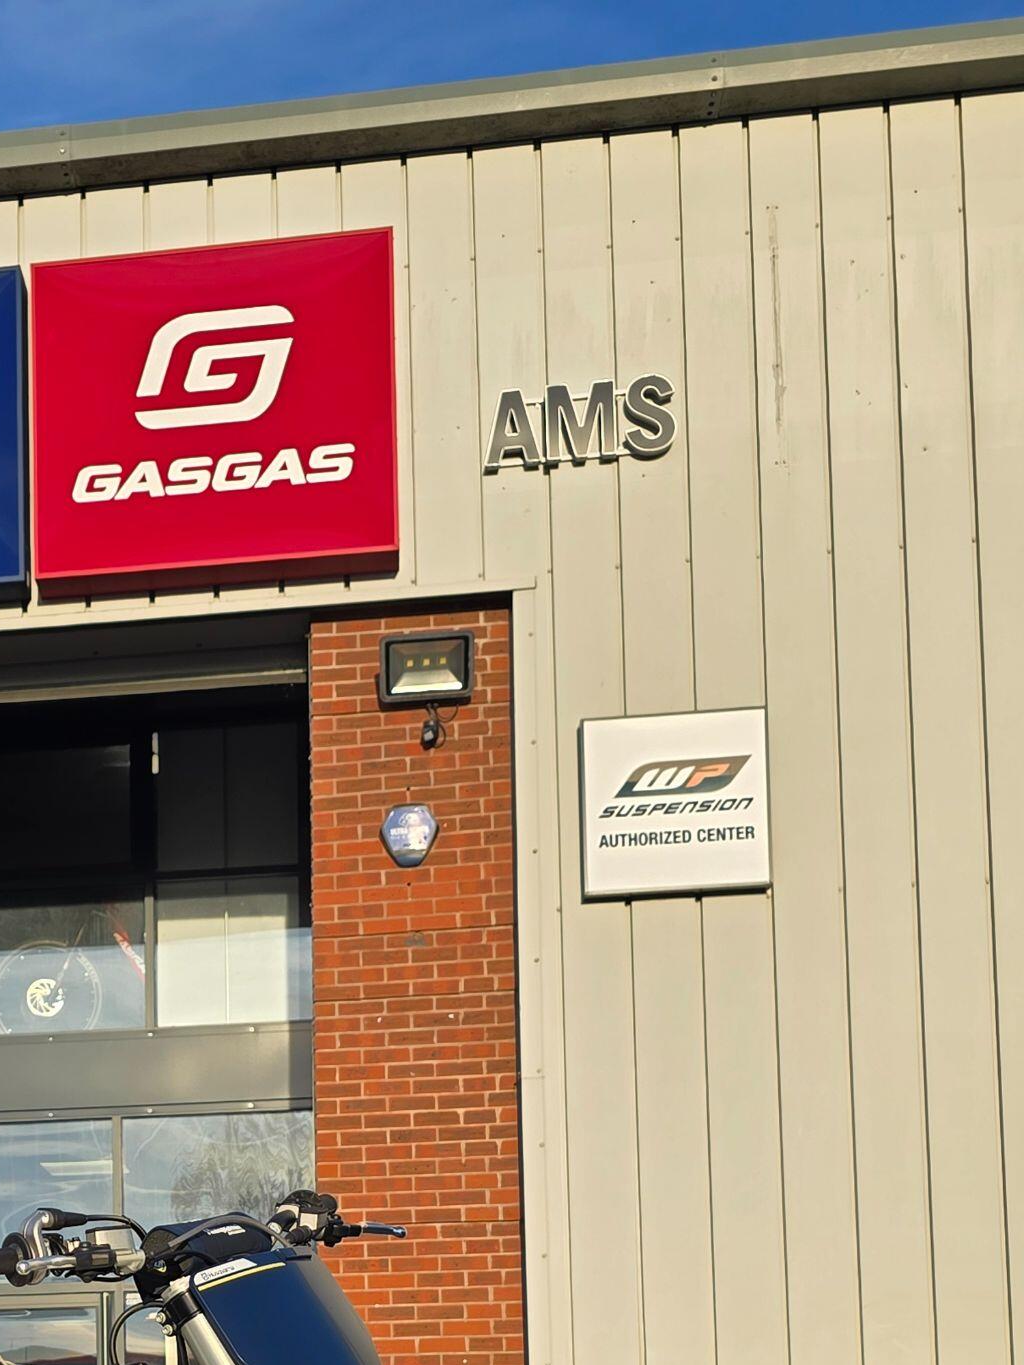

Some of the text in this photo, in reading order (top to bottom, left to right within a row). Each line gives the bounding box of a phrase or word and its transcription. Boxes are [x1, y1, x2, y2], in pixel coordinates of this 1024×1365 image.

[483, 373, 677, 475] AMS
[71, 442, 356, 504] GASGAS
[598, 796, 754, 819] SUSPENSION
[598, 825, 755, 849] AUTHORIZED CENTER
